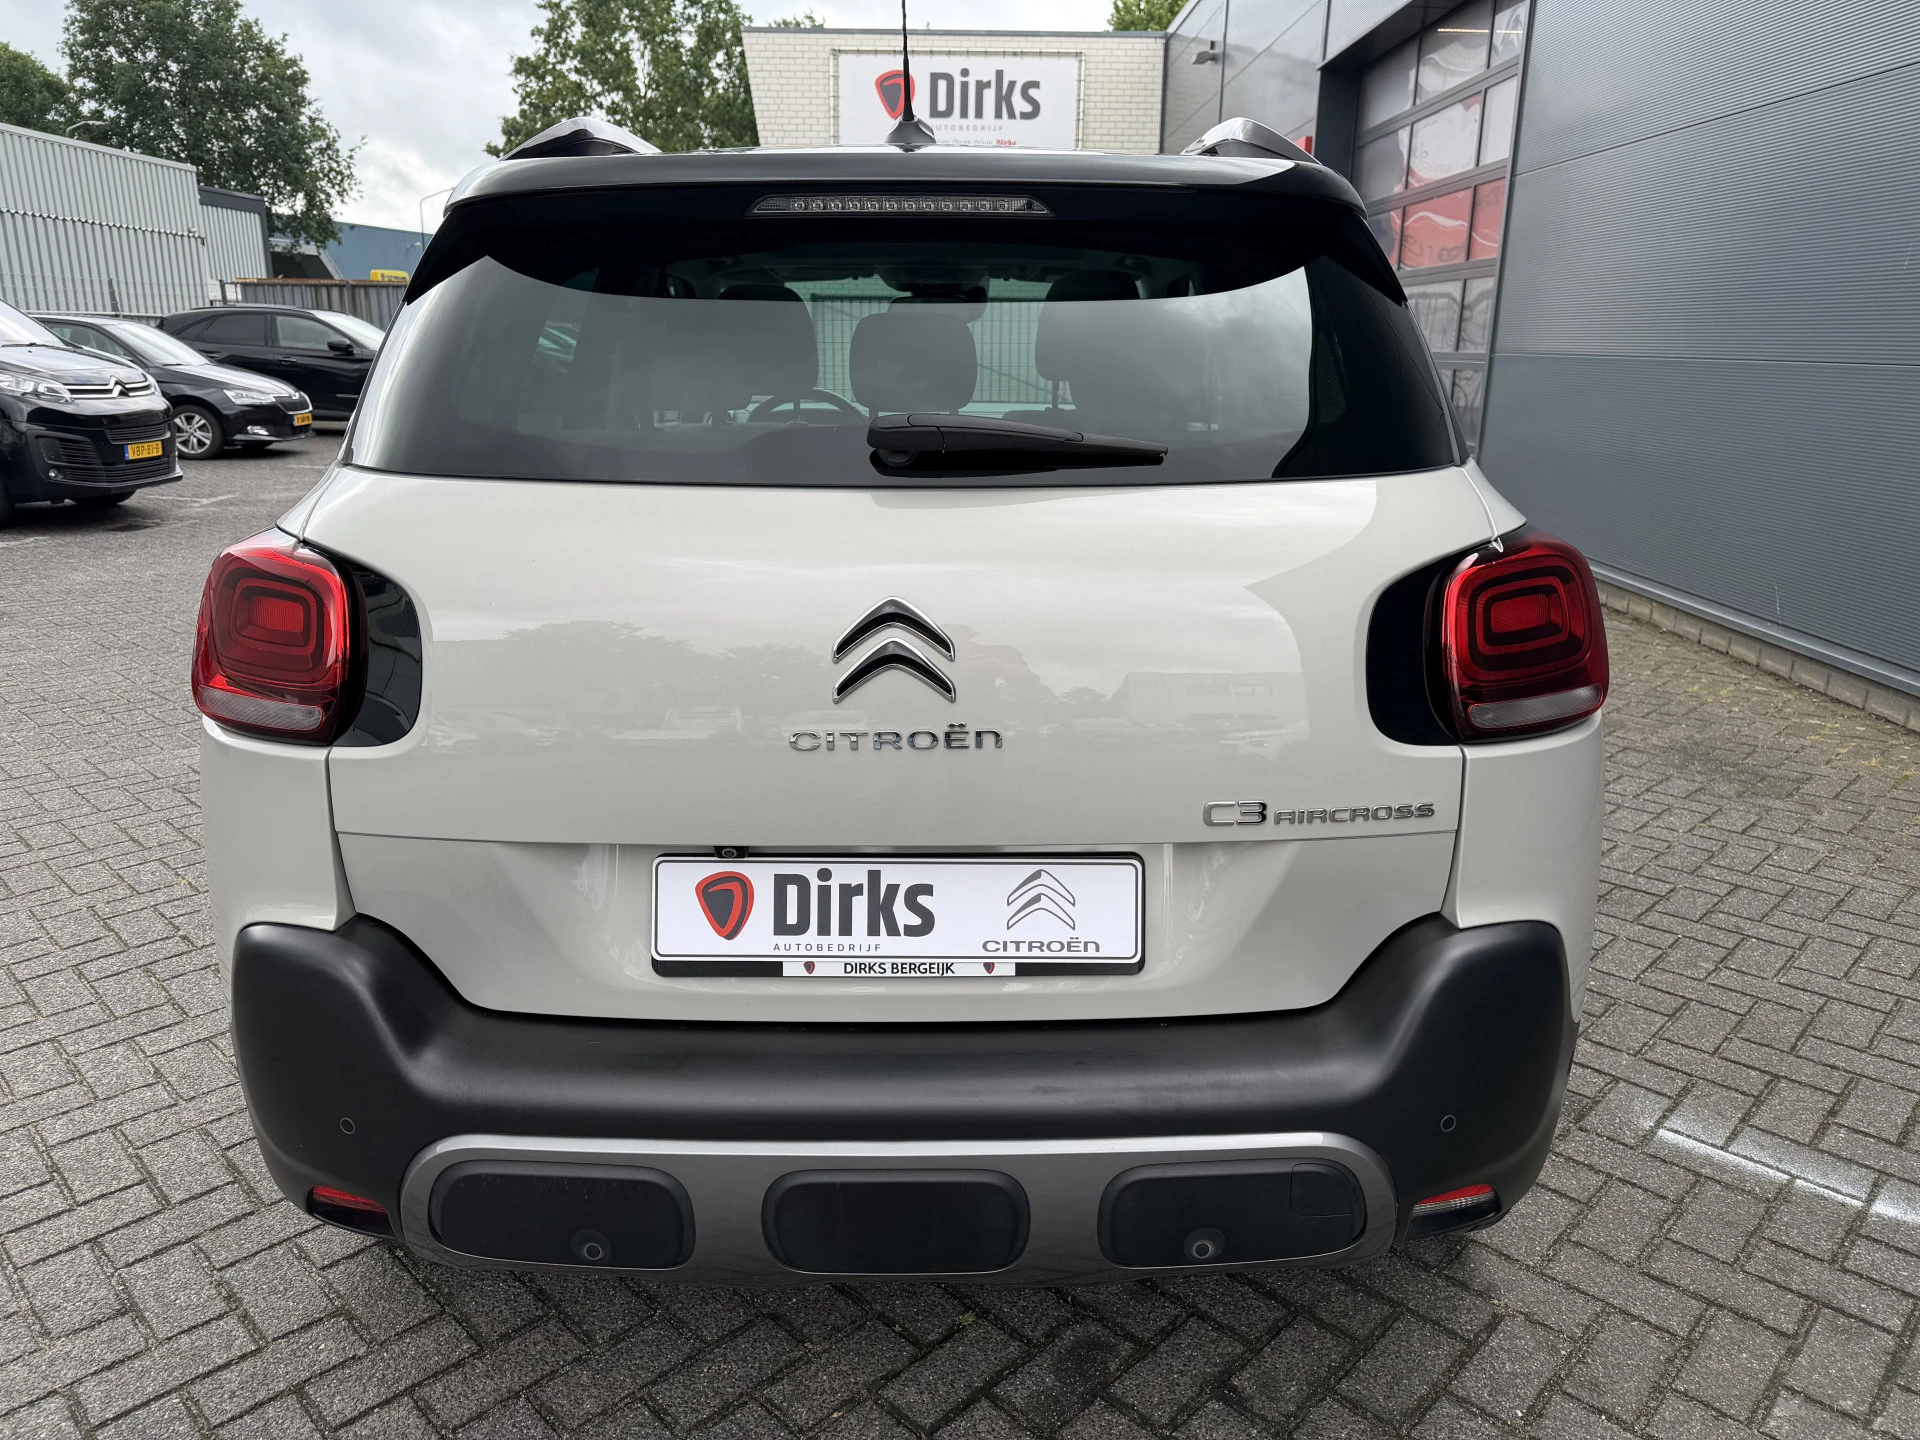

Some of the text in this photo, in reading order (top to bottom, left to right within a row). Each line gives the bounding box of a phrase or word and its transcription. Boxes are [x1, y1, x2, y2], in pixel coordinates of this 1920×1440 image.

[929, 67, 1041, 120] Dirks
[931, 124, 1004, 132] UTOBEDRIJF
[1202, 800, 1436, 827] C3 AIRCROSS
[773, 867, 935, 937] Dirks
[773, 943, 882, 952] AUTOBEDRIJF
[843, 962, 955, 976] DIRKS BERGEIJK
